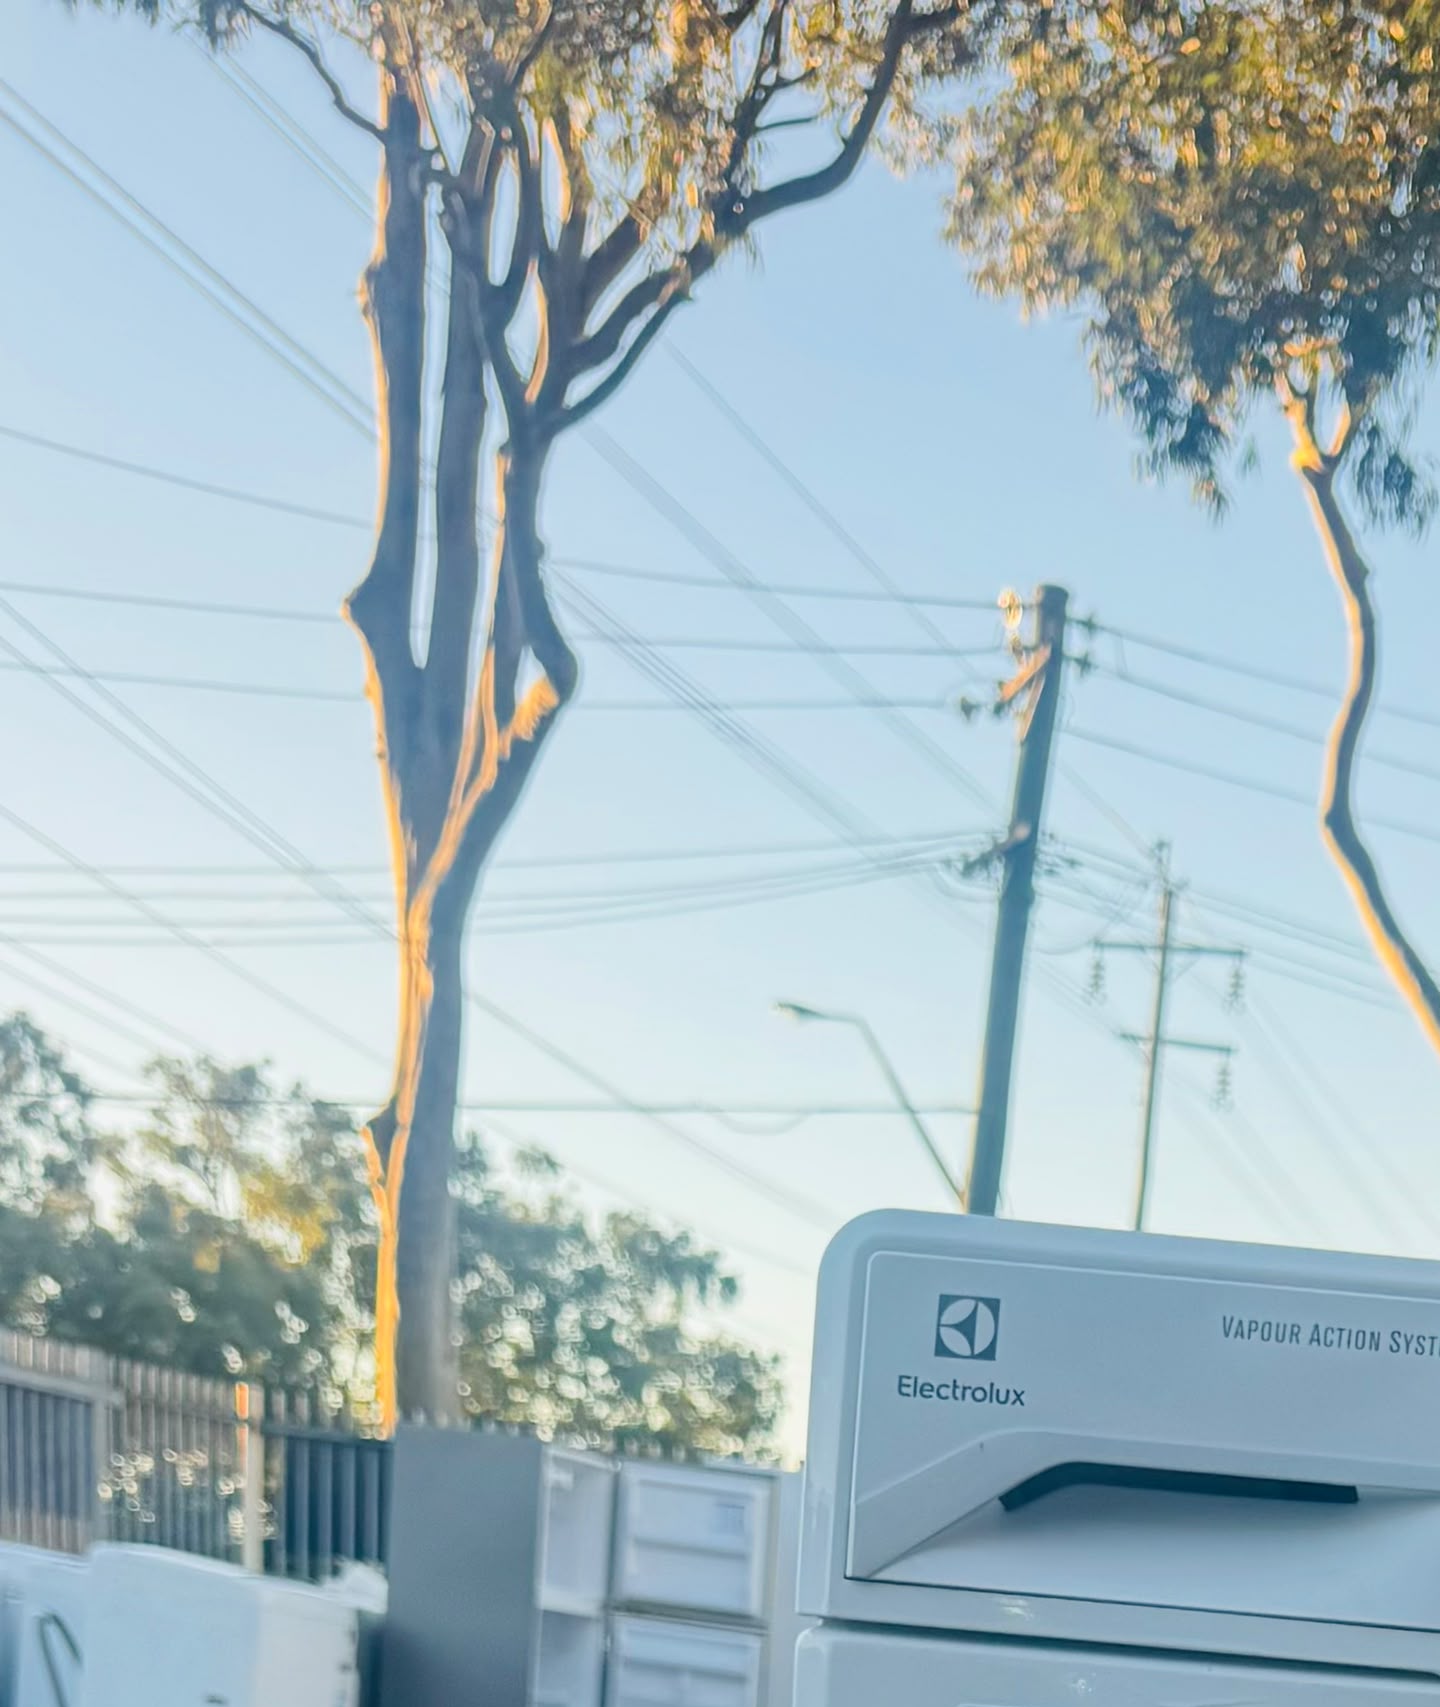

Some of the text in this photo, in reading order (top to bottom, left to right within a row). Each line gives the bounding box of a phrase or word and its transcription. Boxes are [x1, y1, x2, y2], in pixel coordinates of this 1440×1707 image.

[1222, 1315, 1300, 1344] VAPOUR
[1309, 1323, 1381, 1351] ACTION
[896, 1375, 1025, 1406] Electrolux
